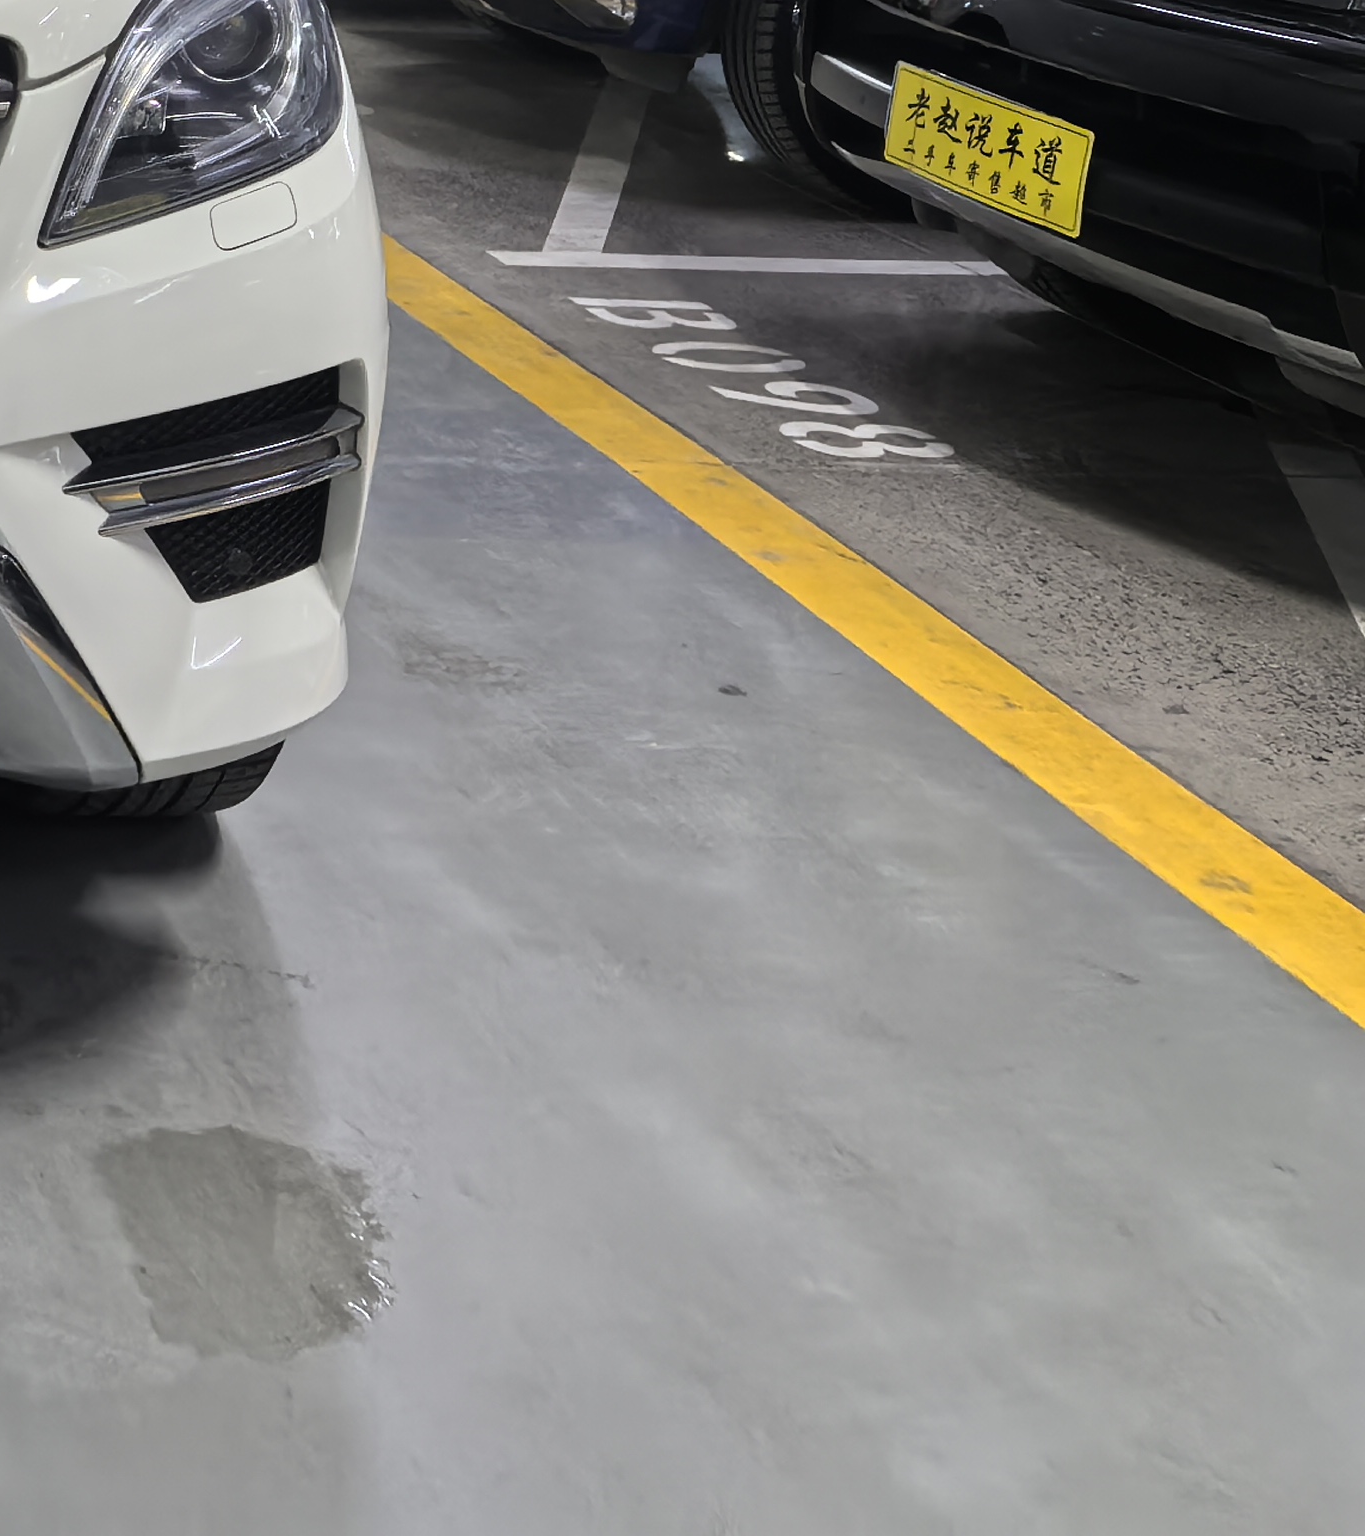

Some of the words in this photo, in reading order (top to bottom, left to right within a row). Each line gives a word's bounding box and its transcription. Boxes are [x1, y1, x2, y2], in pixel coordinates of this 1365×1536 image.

[902, 139, 1054, 217] 二手车寄售超市
[905, 87, 1063, 186] 老赵说车道
[569, 296, 955, 459] B098
